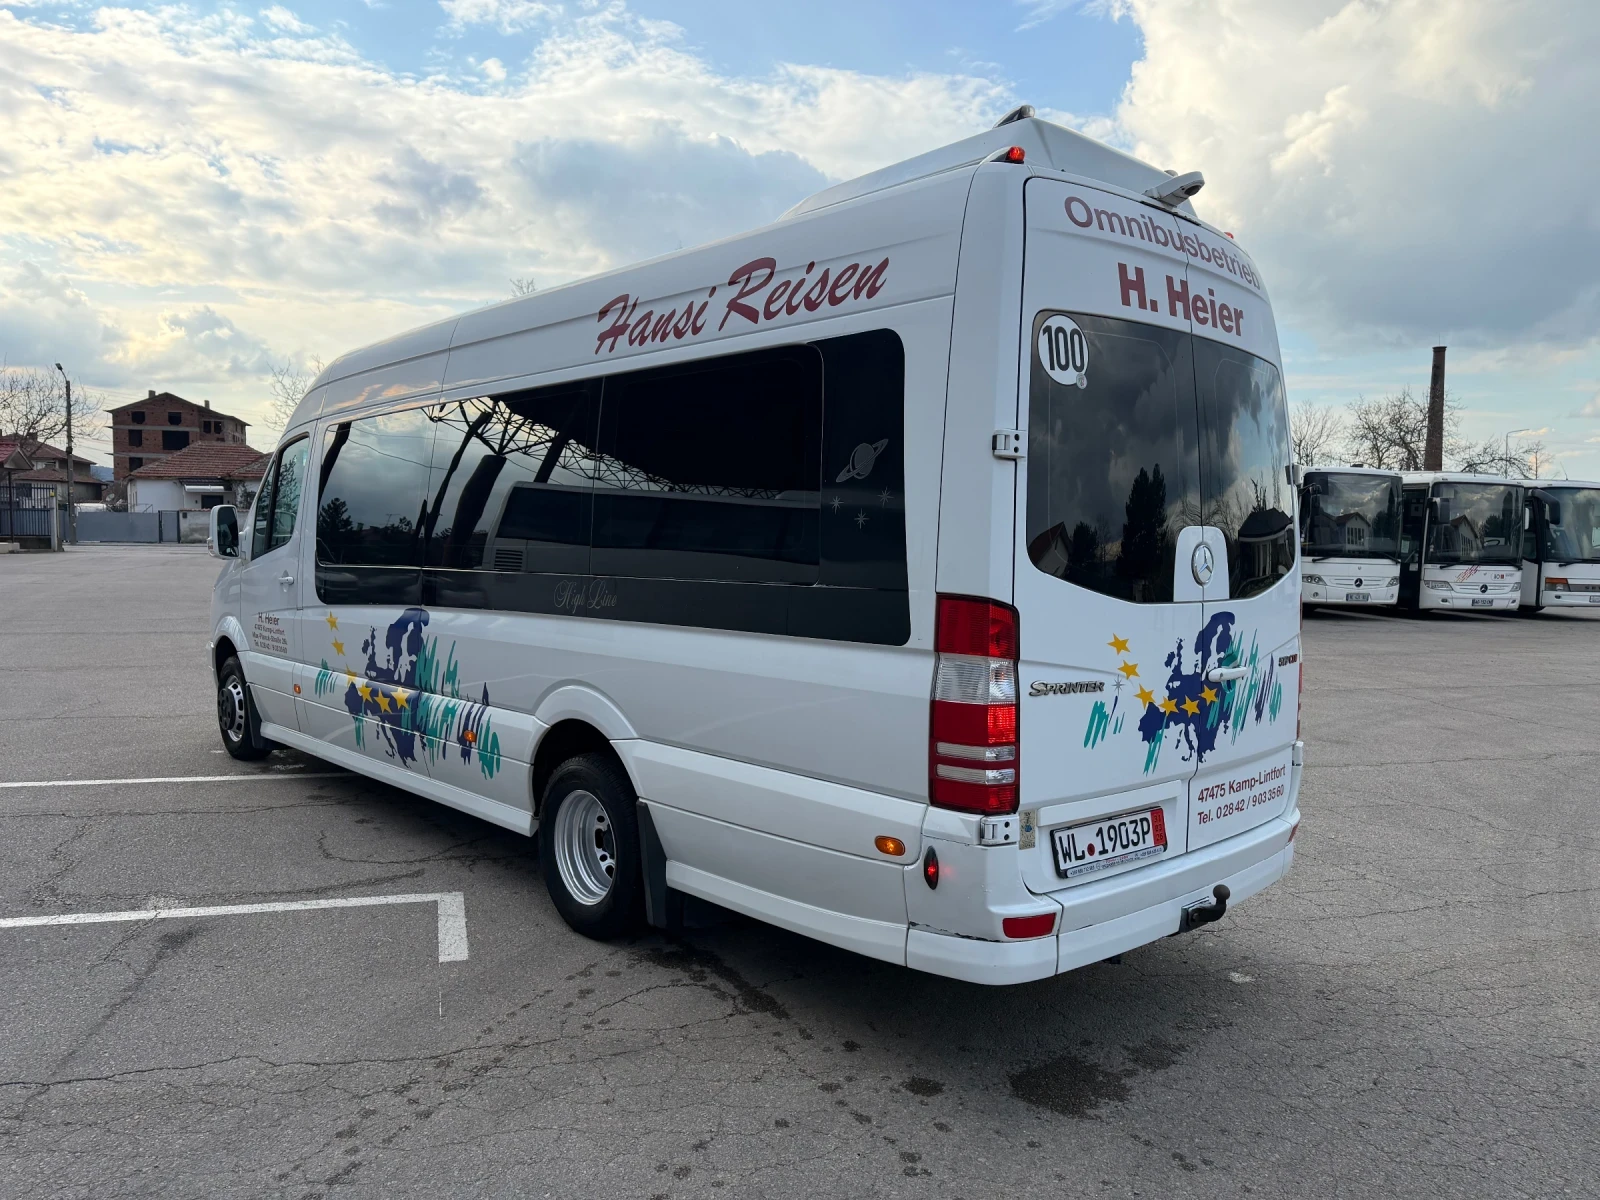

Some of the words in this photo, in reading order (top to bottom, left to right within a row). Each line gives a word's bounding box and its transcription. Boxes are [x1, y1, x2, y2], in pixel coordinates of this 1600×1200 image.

[1064, 196, 1261, 290] Omnibusbetrieb
[594, 286, 717, 355] Hansi
[718, 256, 889, 332] Reisen
[1117, 262, 1158, 313] H.
[1166, 275, 1244, 336] Heier
[1042, 324, 1085, 372] 100
[554, 580, 586, 614] High
[587, 579, 617, 609] Line
[265, 613, 280, 626] Heier
[1197, 783, 1226, 803] 47475
[1228, 764, 1286, 795] Kamp-Lintfort
[1154, 814, 1161, 822] 31
[1197, 809, 1214, 825] Tel.
[1057, 832, 1086, 865] WL
[1096, 816, 1151, 856] 1903P
